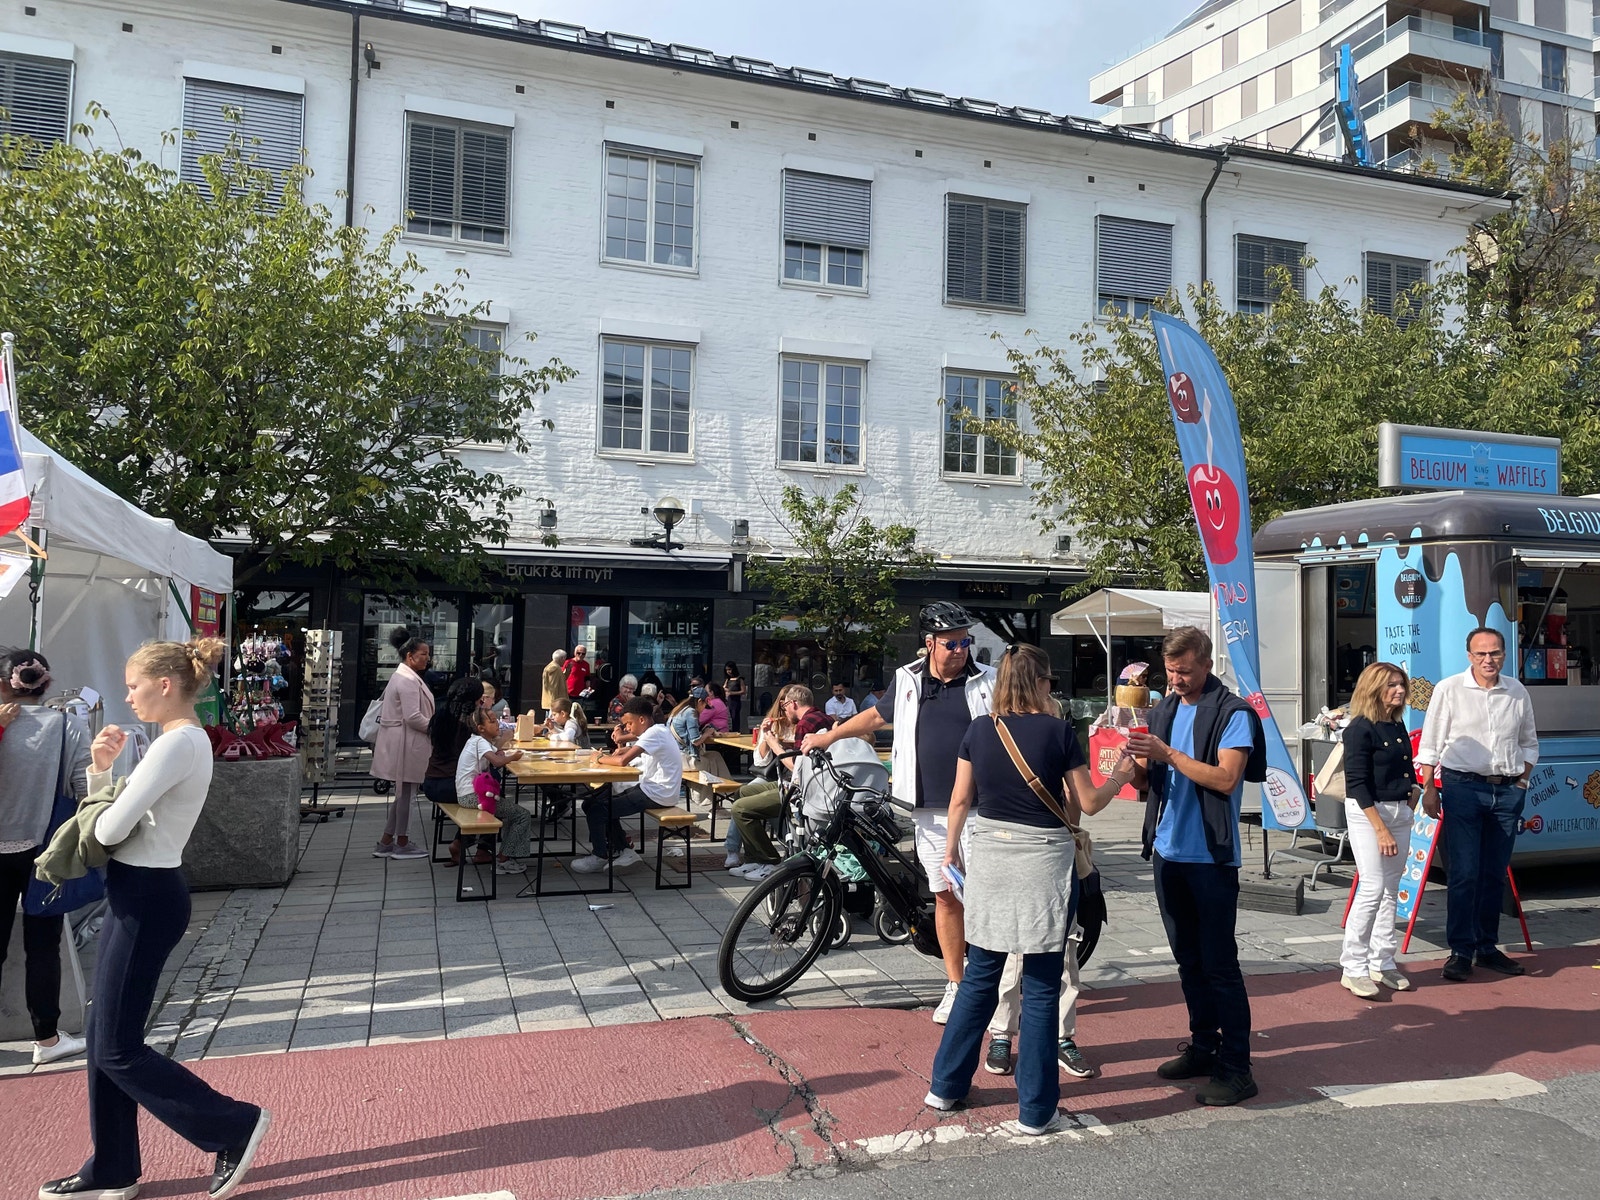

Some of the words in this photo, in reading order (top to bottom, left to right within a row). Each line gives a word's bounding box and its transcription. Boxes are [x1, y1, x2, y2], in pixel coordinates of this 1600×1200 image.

[1410, 457, 1467, 483] BELGIUM
[1497, 464, 1547, 488] WAFFLES
[1537, 507, 1600, 534] BELGIU
[550, 564, 562, 578] &
[1400, 573, 1421, 582] BELGIUM
[378, 610, 404, 624] TIL
[640, 622, 664, 635] TIL
[667, 622, 699, 635] LEIE
[1385, 626, 1405, 639] TASTE
[1407, 624, 1421, 636] THE
[1390, 641, 1421, 655] ORIGINAL
[1530, 782, 1560, 807] ORIGINAL
